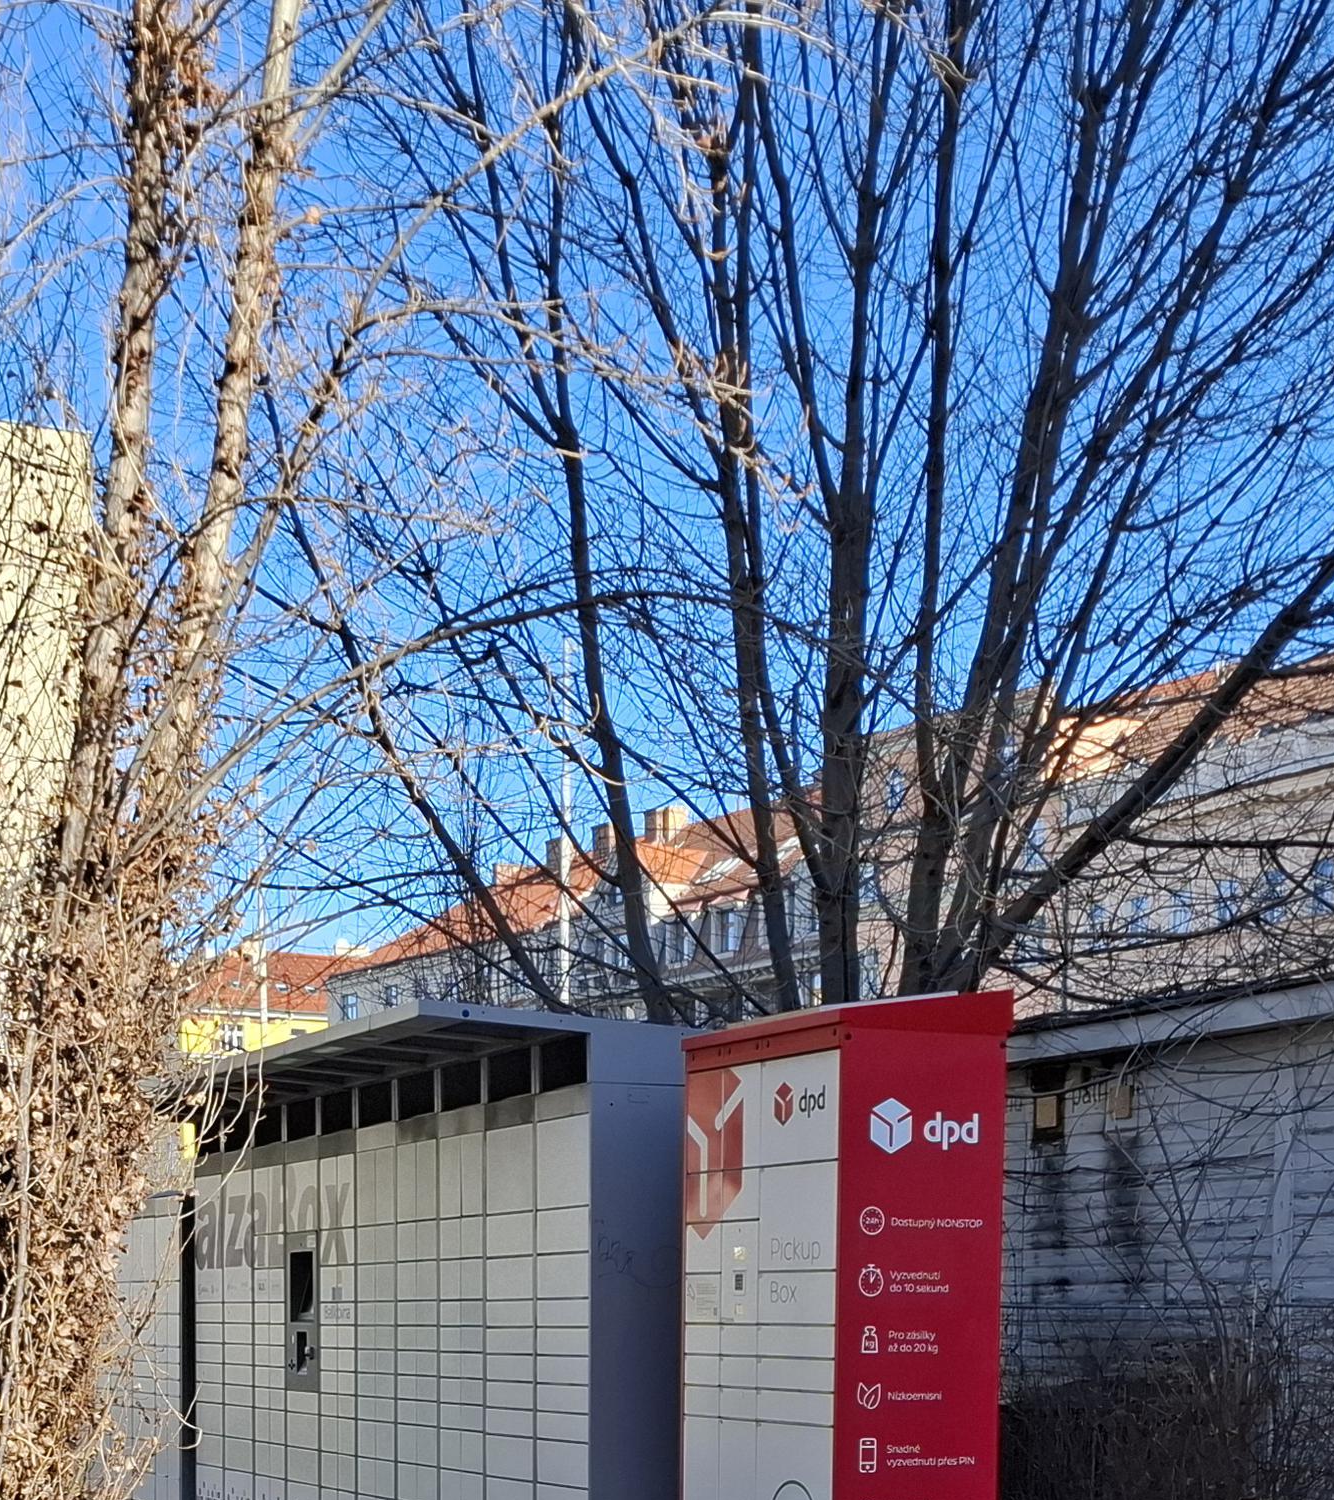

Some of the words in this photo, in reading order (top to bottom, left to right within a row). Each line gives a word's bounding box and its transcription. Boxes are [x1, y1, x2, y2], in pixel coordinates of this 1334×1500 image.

[798, 1084, 826, 1118] dpd
[923, 1111, 979, 1150] dpd
[890, 1216, 936, 1230] Dostupný
[936, 1218, 983, 1229] NONSTOP
[770, 1236, 821, 1265] Pickup
[889, 1270, 941, 1281] Vyzvednutí
[770, 1280, 798, 1303] Box
[889, 1283, 902, 1293] do
[904, 1283, 915, 1292] 10
[916, 1283, 949, 1293] sekund
[888, 1330, 905, 1340] Pro
[906, 1329, 936, 1342] zásilky
[888, 1343, 898, 1353] až
[899, 1343, 912, 1353] do
[913, 1343, 926, 1352] 20
[927, 1343, 939, 1355] kg
[887, 1390, 942, 1401] Nízkoemisní
[886, 1444, 921, 1454] Snadné
[886, 1456, 936, 1468] vyzvednutí
[937, 1456, 958, 1467] přes
[958, 1456, 975, 1465] PIN
